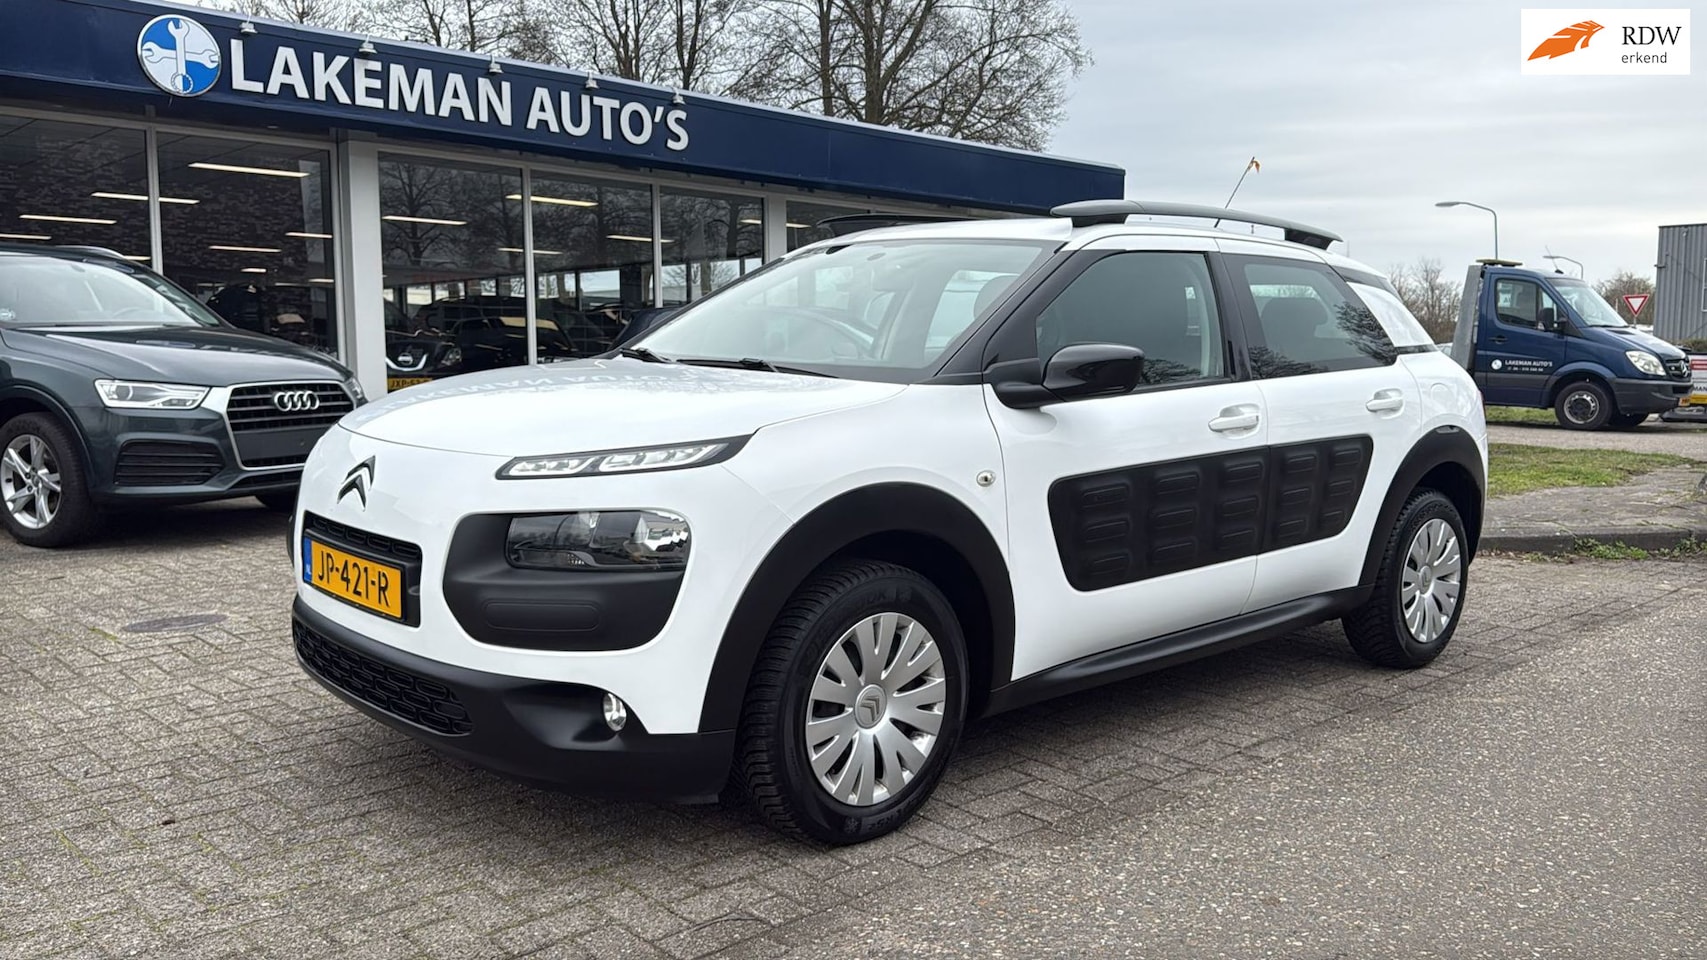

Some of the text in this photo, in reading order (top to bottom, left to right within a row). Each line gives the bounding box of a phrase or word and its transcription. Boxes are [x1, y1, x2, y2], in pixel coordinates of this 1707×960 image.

[230, 38, 690, 151] LAKEMAN AUTO'S
[317, 550, 391, 608] JP-421-R
